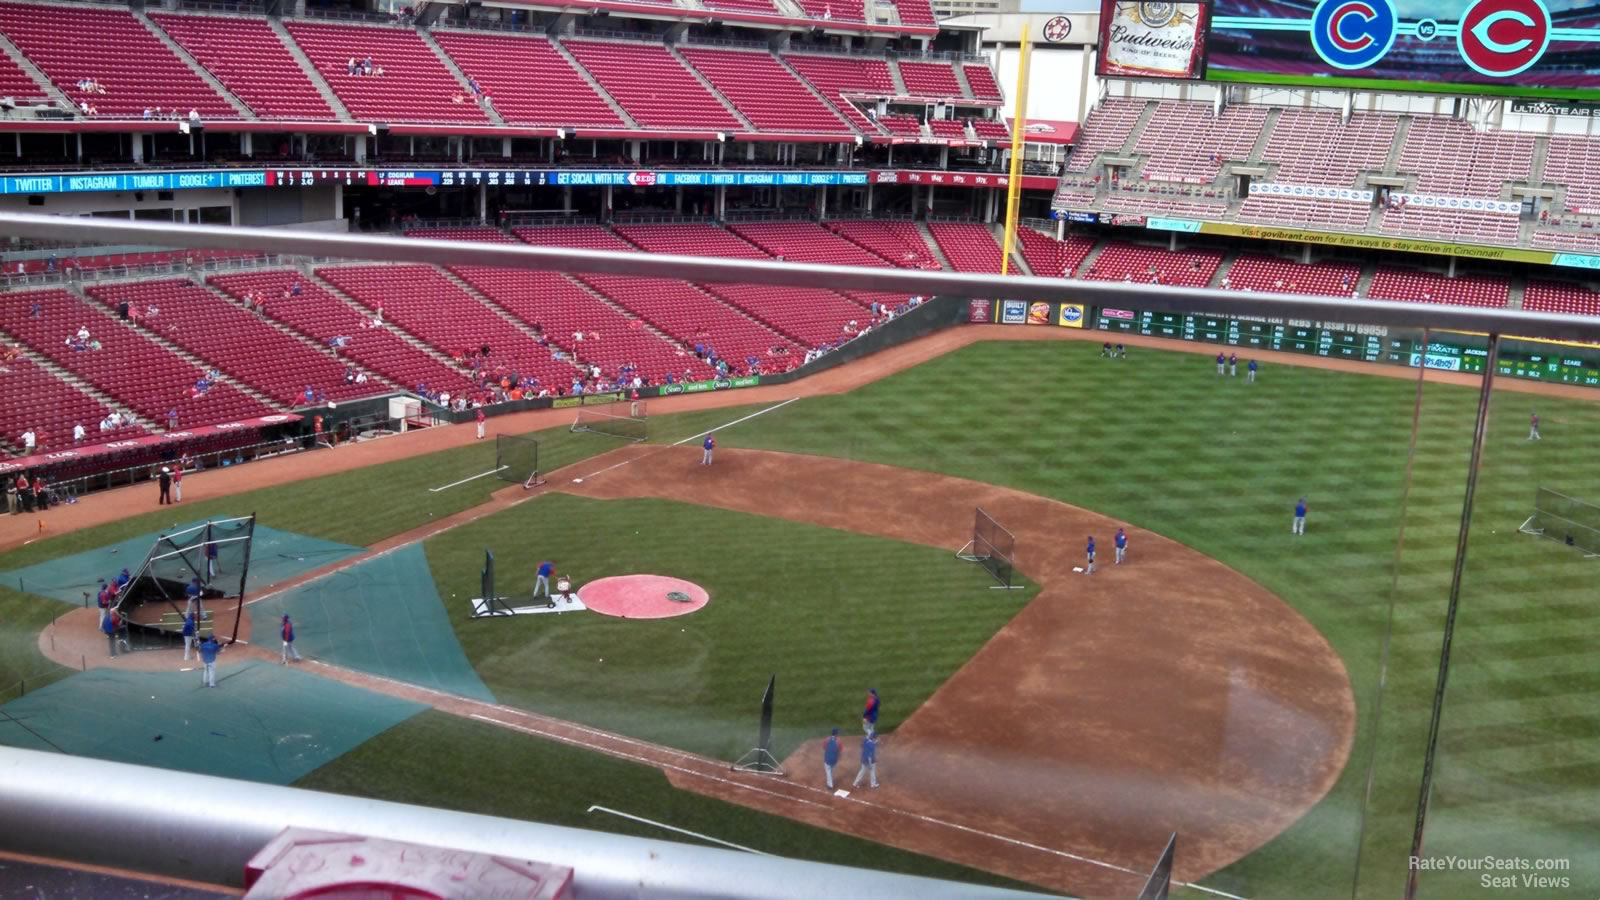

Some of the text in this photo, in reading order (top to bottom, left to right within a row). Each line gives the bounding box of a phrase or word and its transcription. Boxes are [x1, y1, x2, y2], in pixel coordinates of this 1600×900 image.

[1420, 26, 1434, 34] VS
[1110, 24, 1194, 50] Budweiser
[1514, 104, 1569, 115] ULTIMATE
[1570, 108, 1590, 116] AIR
[15, 172, 265, 192] TWITTER INSTAGRAM TUMBLR GOOGLE+ PINTEREST
[558, 173, 570, 184] GET
[571, 173, 593, 184] SOCIAL
[595, 173, 612, 184] WITH
[613, 173, 625, 184] THE
[658, 174, 666, 184] ON
[675, 174, 701, 184] FACEBOOK
[712, 174, 734, 184] TWITTER
[744, 174, 773, 184] INSTAGRAM
[843, 174, 868, 184] PINTEREST
[1241, 228, 1504, 258] Visit govibrant.com for fun ways to stay active in Cincinnati!
[1007, 301, 1025, 309] BUILT
[1324, 322, 1345, 332] ISSUE
[1347, 324, 1355, 333] TO
[1549, 363, 1558, 372] VS
[1564, 359, 1582, 367] LEAKE
